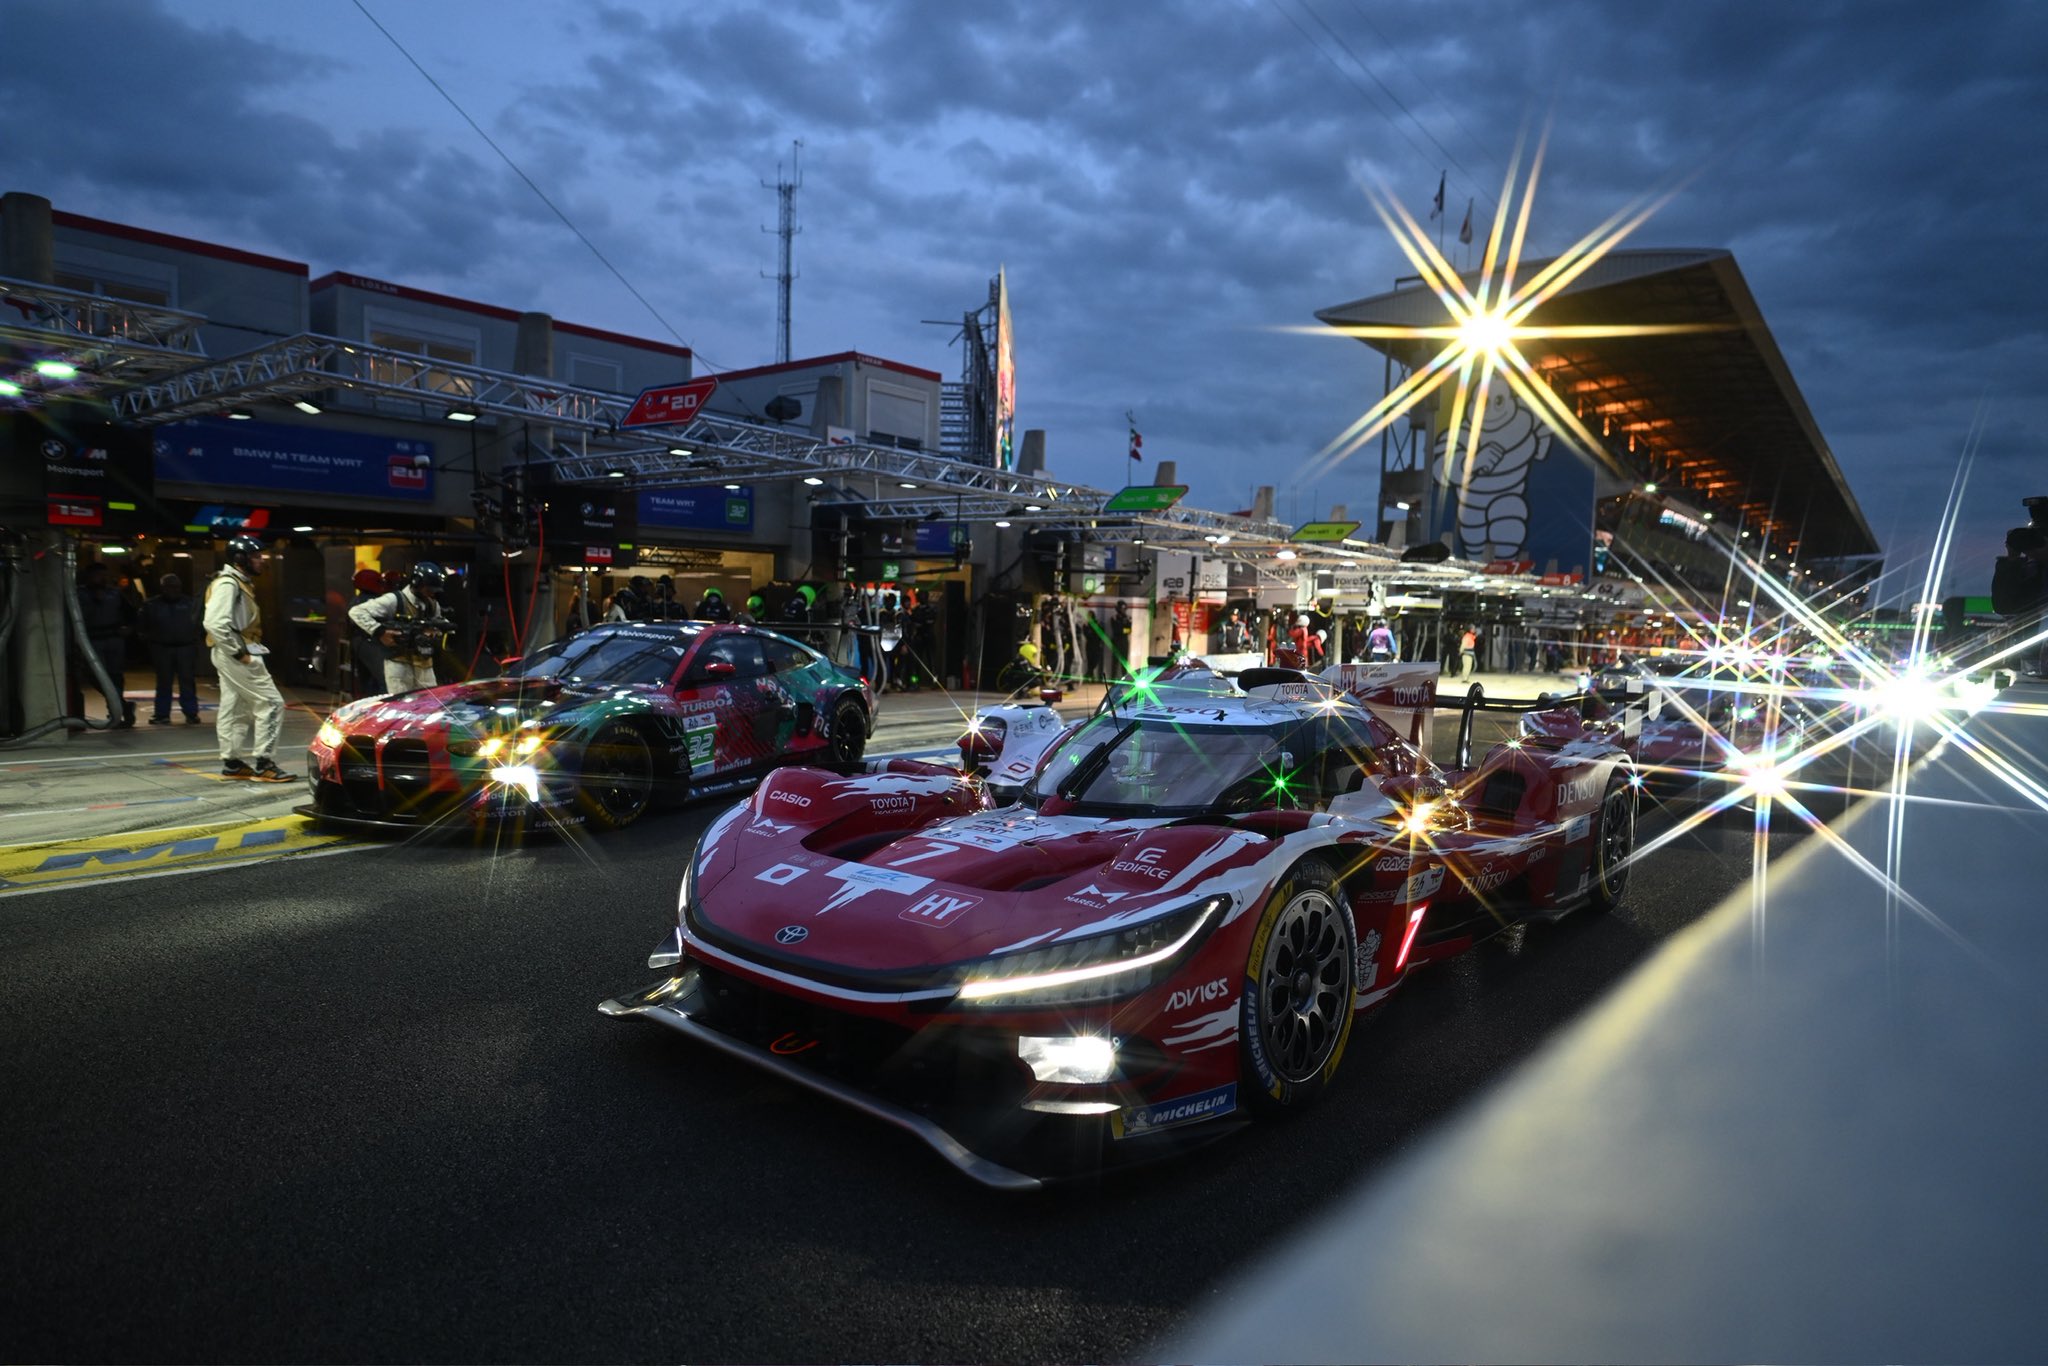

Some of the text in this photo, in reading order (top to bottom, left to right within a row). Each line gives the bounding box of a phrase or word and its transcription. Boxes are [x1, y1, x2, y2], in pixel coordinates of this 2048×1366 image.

[671, 394, 697, 410] 20
[232, 447, 364, 468] BMW M TEAM WRT
[46, 464, 105, 477] Motorsport
[649, 496, 697, 508] TEAM WRT
[583, 519, 614, 529] Motorsport
[1257, 567, 1298, 578] TOYOTA
[1512, 562, 1520, 573] 7
[1563, 575, 1571, 585] 8
[1598, 583, 1613, 594] 62
[616, 629, 676, 641] Motorsport
[1341, 671, 1355, 691] HY
[1281, 684, 1309, 695] TOYOTA
[1392, 687, 1430, 706] TOYOTA
[680, 698, 724, 713] TURBO
[688, 732, 714, 761] 32
[768, 790, 813, 808] CASIO
[1558, 776, 1597, 807] DENSO
[869, 796, 916, 812] TOYOTA 7
[885, 842, 960, 867] 7
[1113, 861, 1172, 881] EDIFICE
[1376, 856, 1412, 872] RAYS
[1457, 869, 1510, 896] FUJITSU
[906, 893, 974, 921] HY
[1063, 896, 1107, 910] MARELLI
[1247, 990, 1270, 1080] MICHELIN
[1152, 1093, 1229, 1124] MICHELIN
